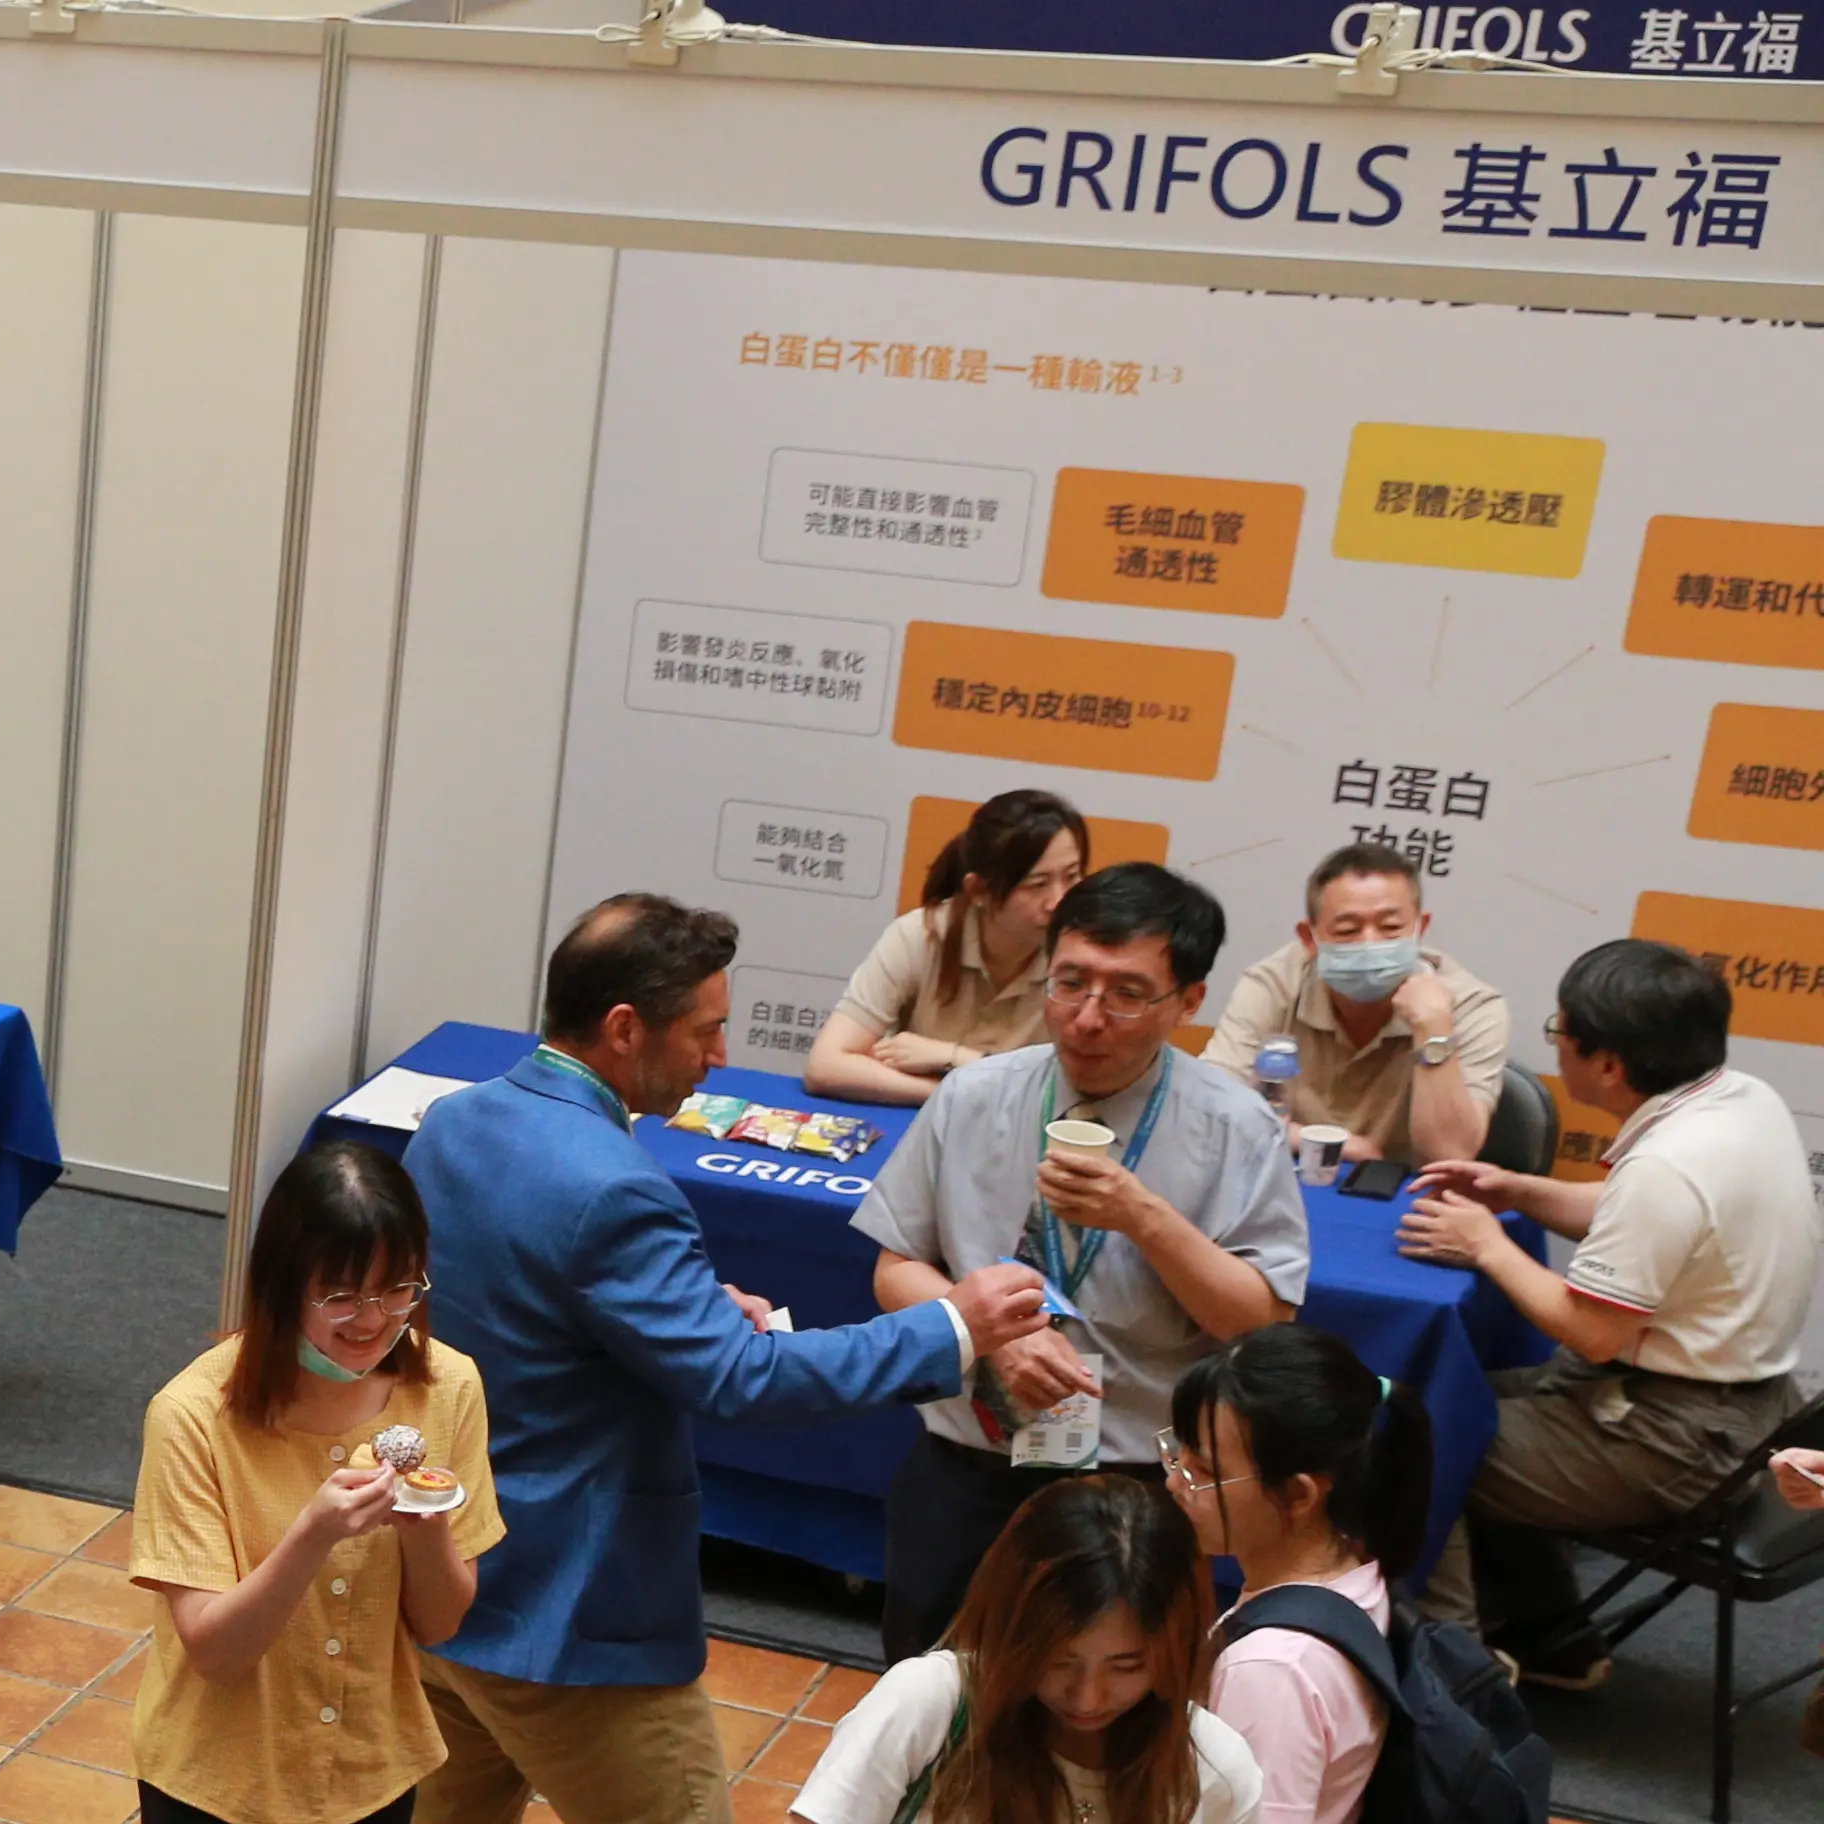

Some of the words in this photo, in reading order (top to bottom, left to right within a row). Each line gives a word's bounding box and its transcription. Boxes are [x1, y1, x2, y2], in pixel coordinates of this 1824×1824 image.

[1330, 2, 1591, 65] GIFOLS
[1630, 9, 1804, 74] 基立福
[979, 126, 1411, 228] GRIFOLS
[1441, 142, 1782, 251] 基立福
[739, 331, 1143, 397] 白蛋白不僅僅是一種輸液
[808, 482, 999, 523] 可能直接影響血管
[1104, 503, 1246, 546] 毛細血管
[1374, 480, 1565, 528] 膠體滲透壓
[1114, 547, 1220, 584] 通透性
[1334, 759, 1490, 820] 白蛋白
[756, 822, 848, 853] 能夠結合
